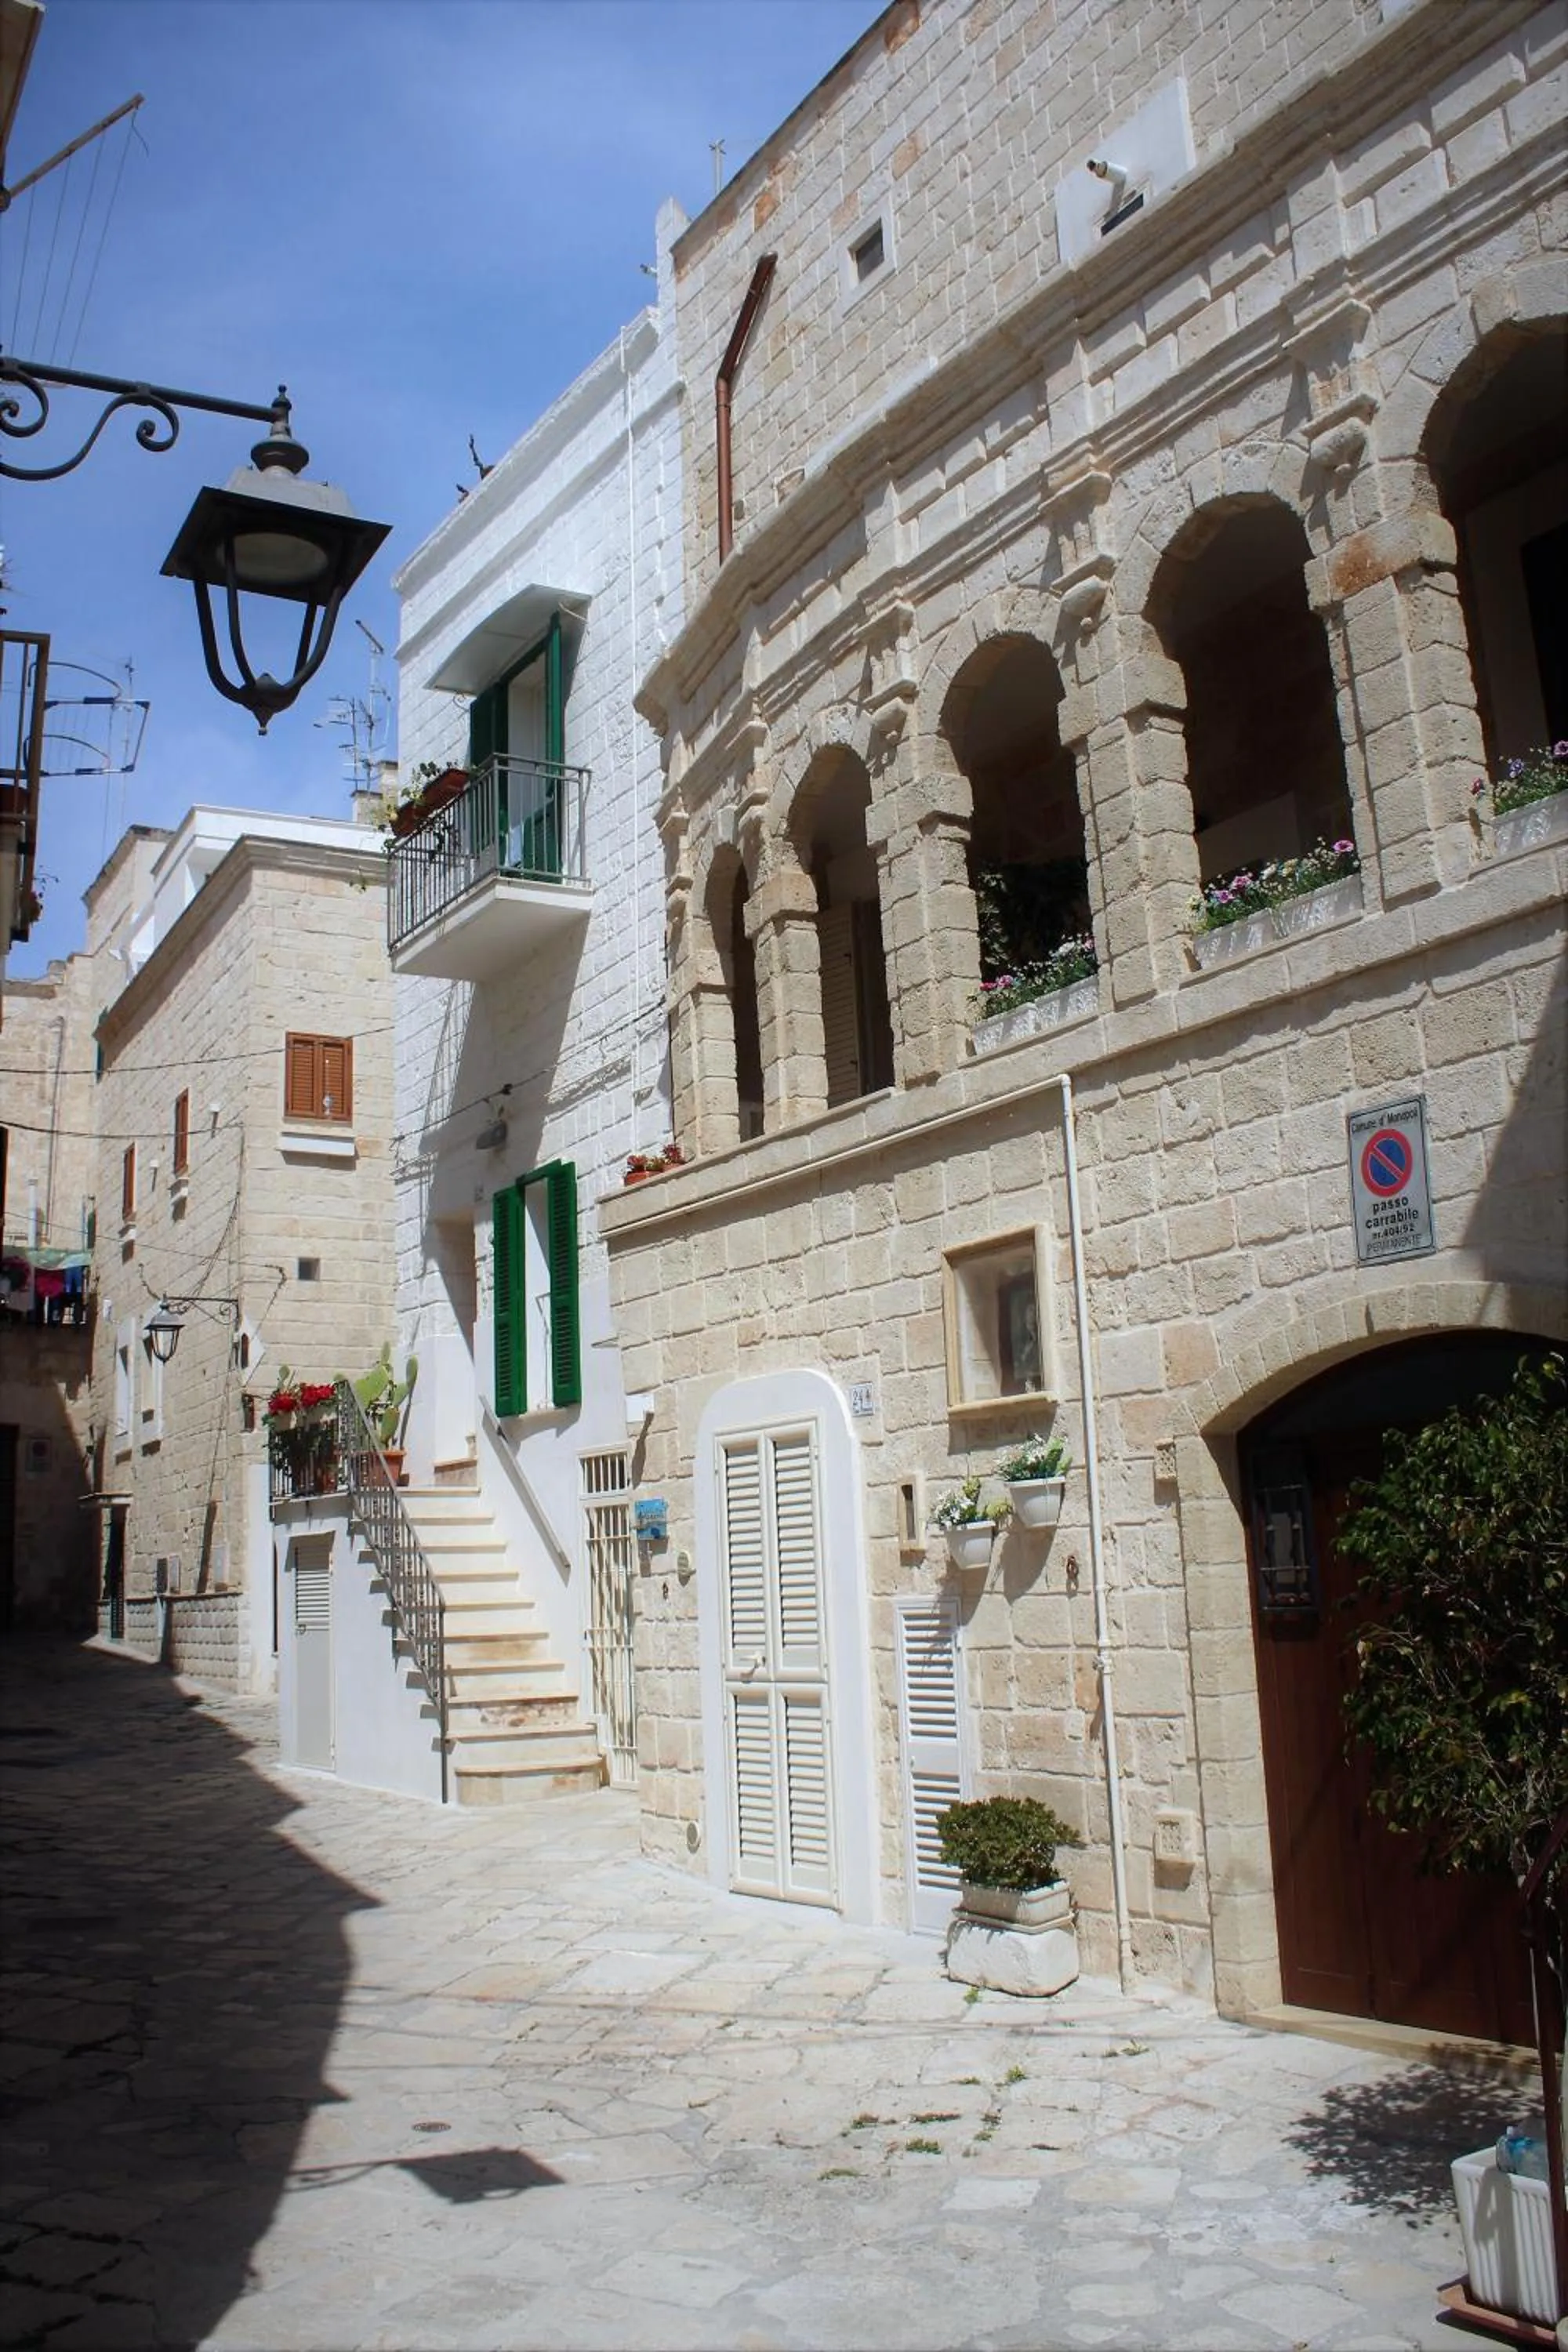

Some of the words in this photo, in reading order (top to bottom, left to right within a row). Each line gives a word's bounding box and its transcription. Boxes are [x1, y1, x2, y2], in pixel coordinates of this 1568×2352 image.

[1351, 1119, 1377, 1134] Comune
[1387, 1108, 1417, 1123] Monopoli
[1373, 1196, 1409, 1215] passo
[1366, 1208, 1418, 1229] carrabile
[1367, 1234, 1421, 1254] PERMANENTE
